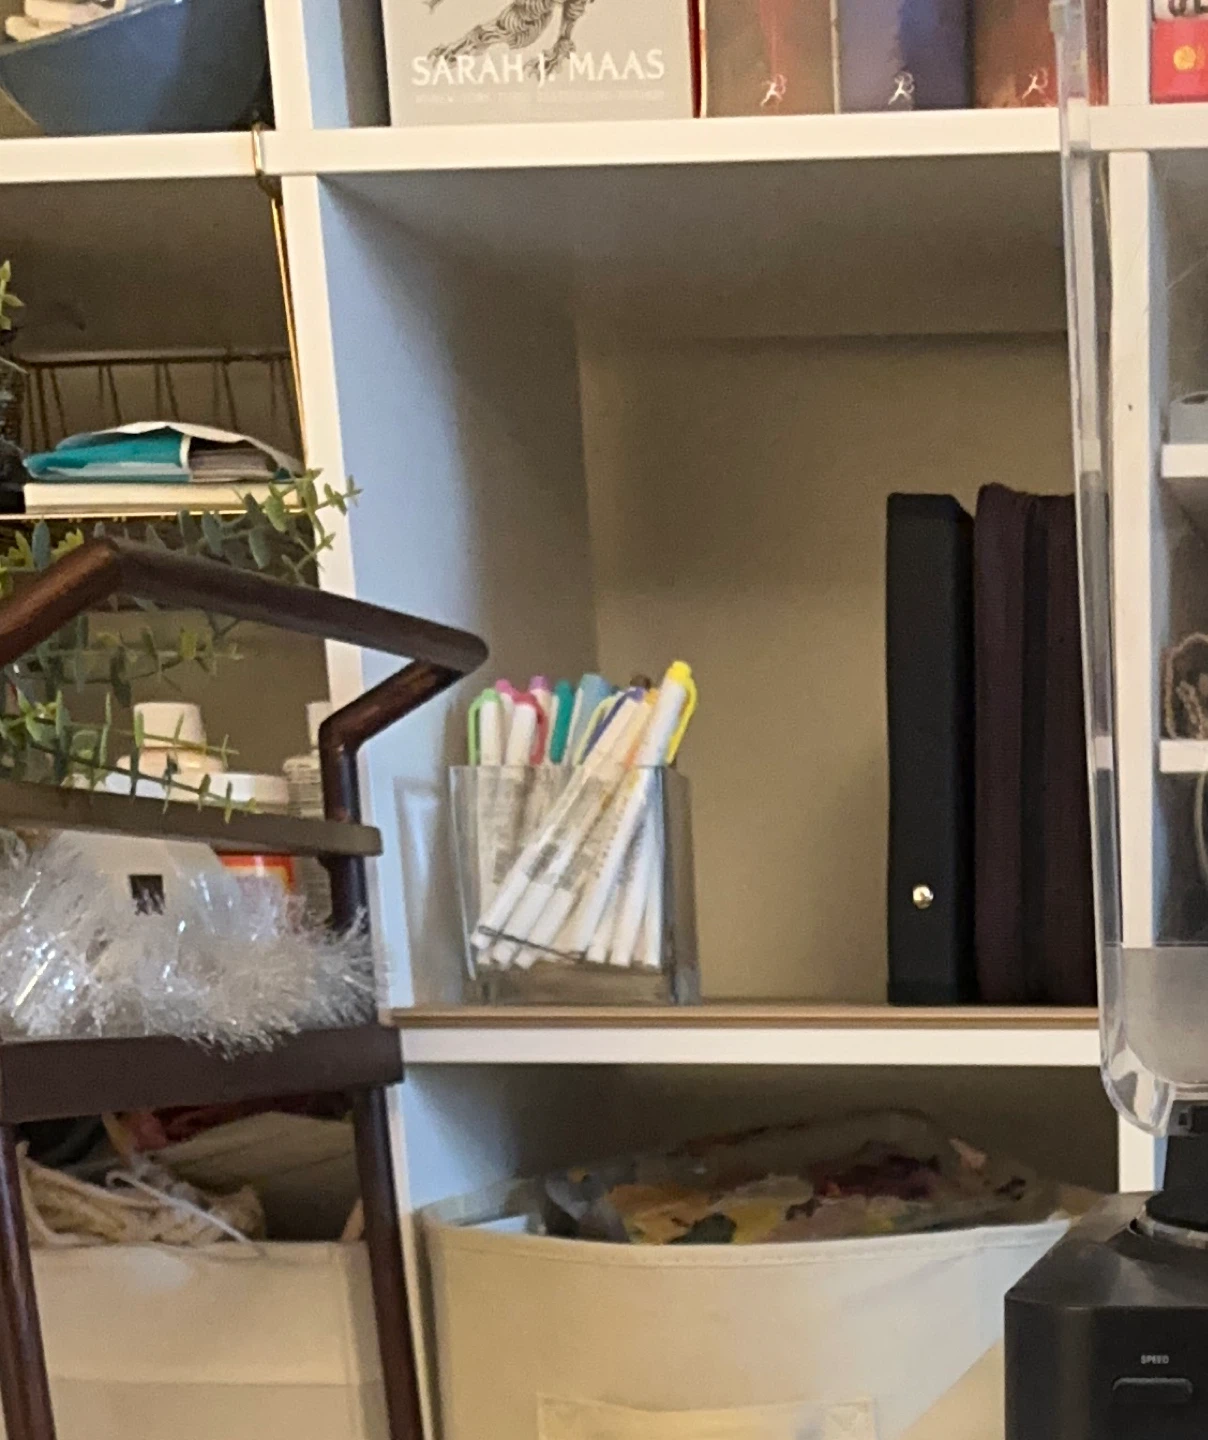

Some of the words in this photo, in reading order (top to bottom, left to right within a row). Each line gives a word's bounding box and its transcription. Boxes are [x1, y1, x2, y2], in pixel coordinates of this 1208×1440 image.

[411, 53, 525, 86] SARAH
[536, 52, 556, 88] J.
[569, 48, 665, 82] MAAS
